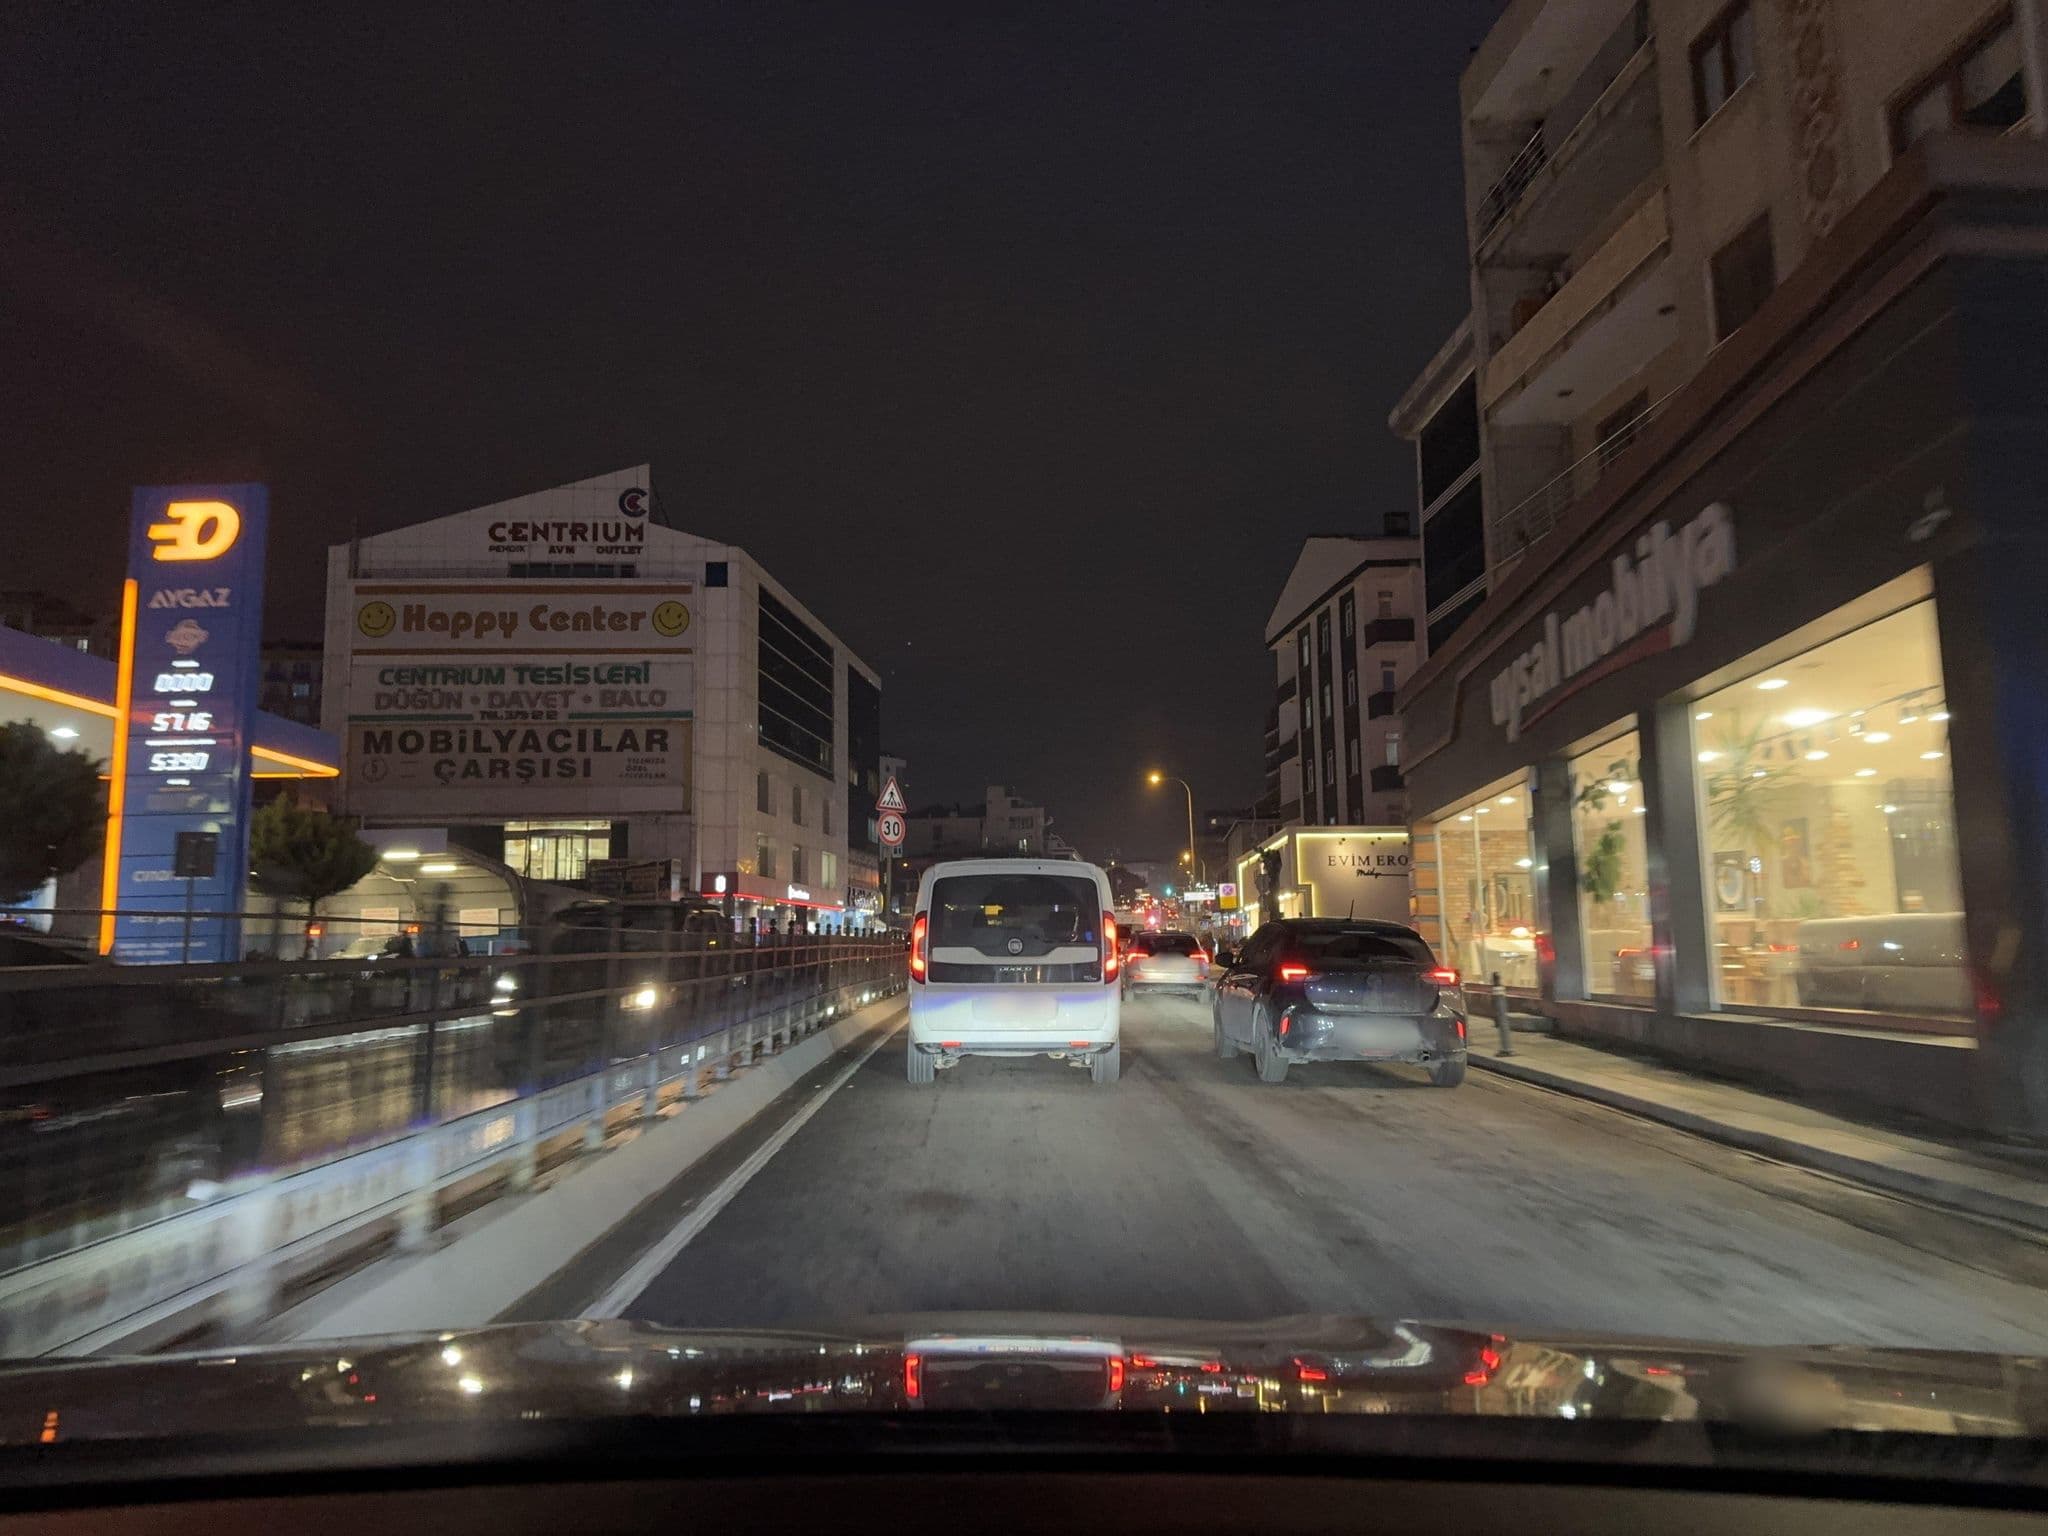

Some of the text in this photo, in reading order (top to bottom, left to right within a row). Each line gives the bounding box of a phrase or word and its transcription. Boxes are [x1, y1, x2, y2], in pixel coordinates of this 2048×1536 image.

[488, 521, 645, 543] CENTRIUM
[548, 545, 576, 555] AVM
[596, 545, 644, 555] OUTLET
[147, 587, 232, 609] AYGAZ
[1561, 502, 1736, 679] mobilya
[403, 604, 648, 640] Happy Center
[378, 665, 506, 687] CENTRIUM
[374, 687, 668, 711] DÜĞÜN DAVET BALO
[433, 758, 592, 785] ÇARŞISI
[883, 820, 900, 836] 30
[1327, 853, 1370, 867] EVİM
